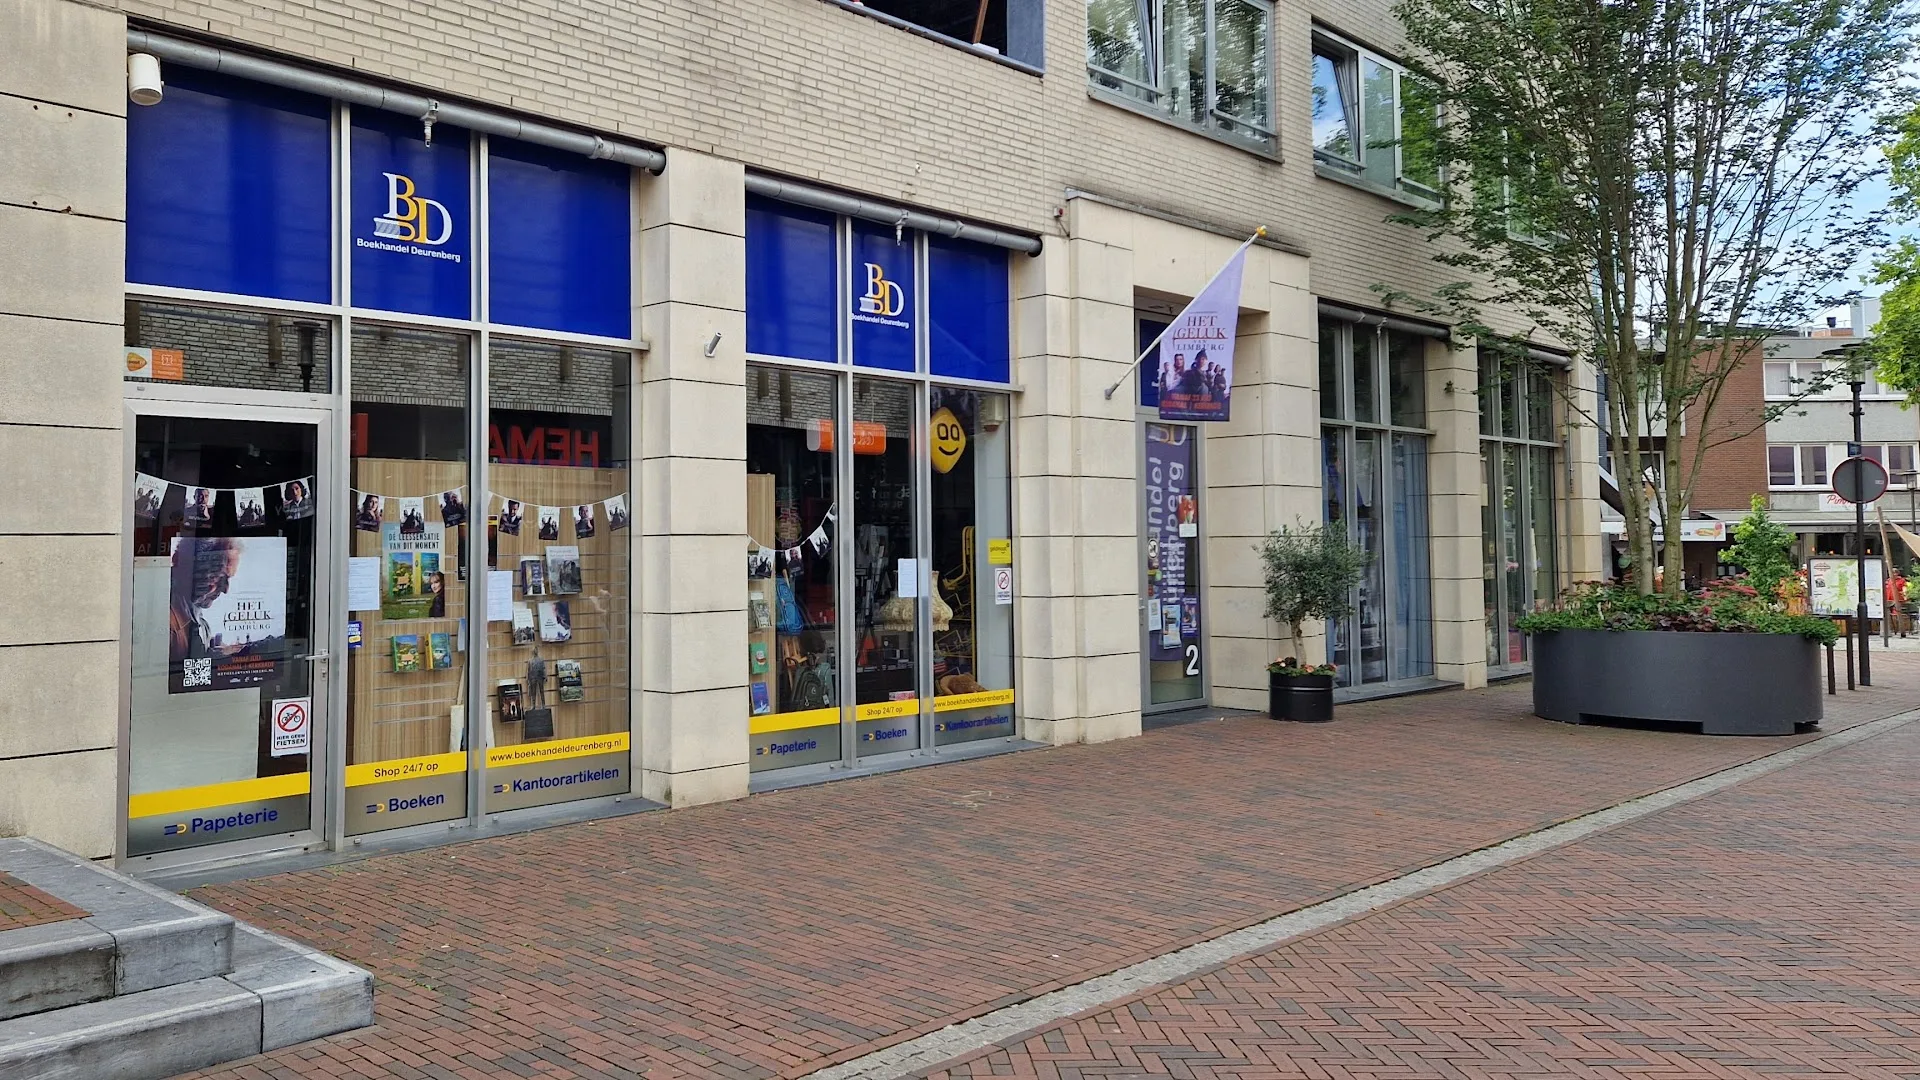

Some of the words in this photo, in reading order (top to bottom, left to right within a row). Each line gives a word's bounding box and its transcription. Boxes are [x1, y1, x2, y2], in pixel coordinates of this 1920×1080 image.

[356, 237, 410, 254] Boekhandel
[410, 246, 461, 263] Deurenberg
[880, 317, 910, 329] Deurenberg
[1187, 315, 1218, 327] HET
[1176, 327, 1226, 339] GELUK
[388, 532, 397, 541] DÉ
[398, 532, 440, 541] LEESSENSATIE
[389, 542, 401, 550] VAN
[403, 542, 413, 550] DIT
[415, 541, 439, 550] MOMENT
[237, 601, 264, 611] HET
[227, 610, 271, 621] GELUK
[228, 624, 271, 632] LIMBURG
[1186, 645, 1199, 676] 2
[867, 707, 881, 716] Shop
[882, 706, 894, 714] 24/7
[896, 706, 903, 714] op
[946, 715, 1009, 731] Kantoorartikelen
[875, 728, 907, 740] Boeken
[489, 739, 622, 762] www.boekhandeldeurenberg.nl
[770, 738, 817, 755] Papeterie
[374, 767, 400, 778] Shop
[403, 763, 423, 773] 24/7
[426, 763, 439, 773] op
[513, 767, 619, 793] Kantoorartikelen
[388, 793, 445, 812] Boeken
[191, 807, 279, 834] Papeterie
